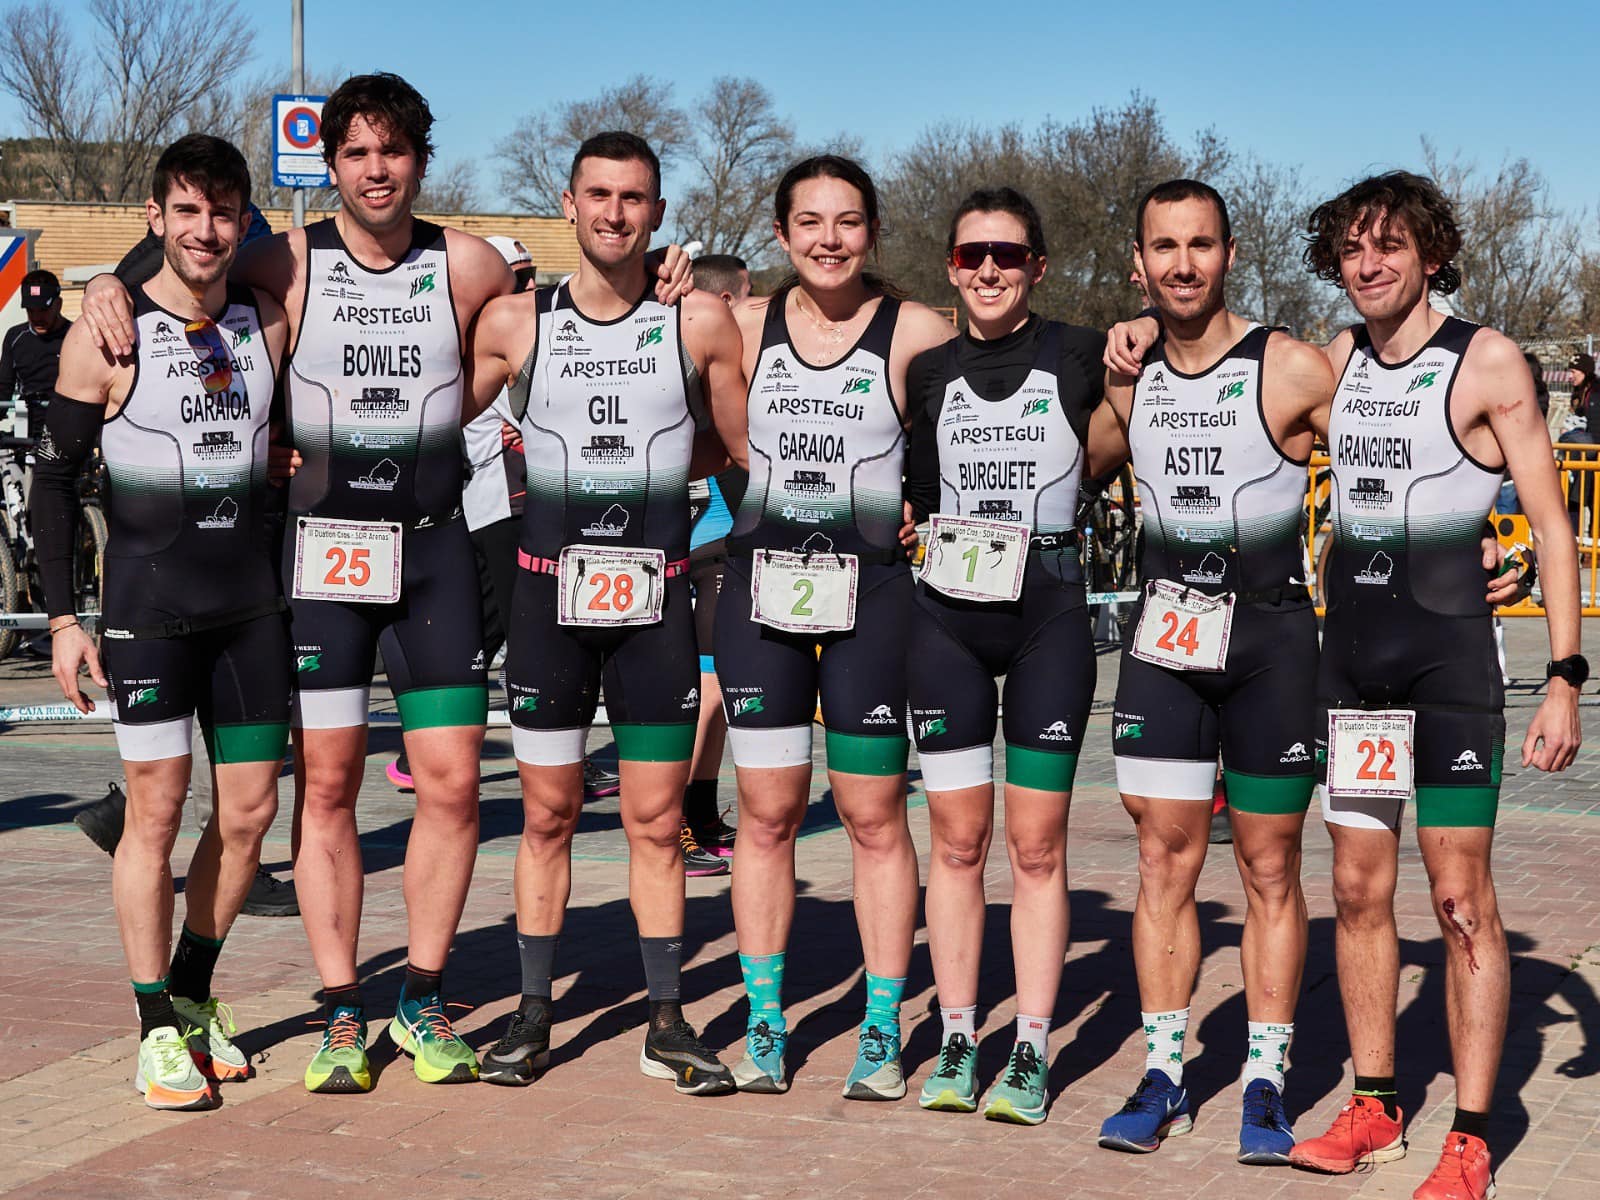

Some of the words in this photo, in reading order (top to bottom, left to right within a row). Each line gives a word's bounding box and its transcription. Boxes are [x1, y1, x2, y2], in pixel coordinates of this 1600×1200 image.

[343, 344, 422, 378] BOWLES
[181, 391, 251, 423] GARAIOA
[351, 399, 408, 411] muruzabal
[588, 395, 628, 425] GIL
[194, 441, 241, 454] muruzabal
[582, 446, 633, 457] muruzabal
[779, 432, 845, 464] GARAIOA
[1164, 447, 1224, 476] ASTIZ
[1338, 433, 1412, 470] ARANGUREN
[785, 480, 834, 493] muruzabal
[958, 461, 1036, 491] BURGUETE
[1171, 496, 1219, 507] muruzabal
[1350, 489, 1392, 502] muruzabal
[970, 510, 1020, 521] muruzabal
[323, 547, 371, 587] 25
[962, 545, 979, 582] 1
[587, 573, 633, 612] 28
[790, 579, 814, 616] 2
[1156, 611, 1199, 656] 24
[19, 707, 44, 716] CAJA
[46, 707, 80, 716] RURAL
[1356, 740, 1396, 780] 22
